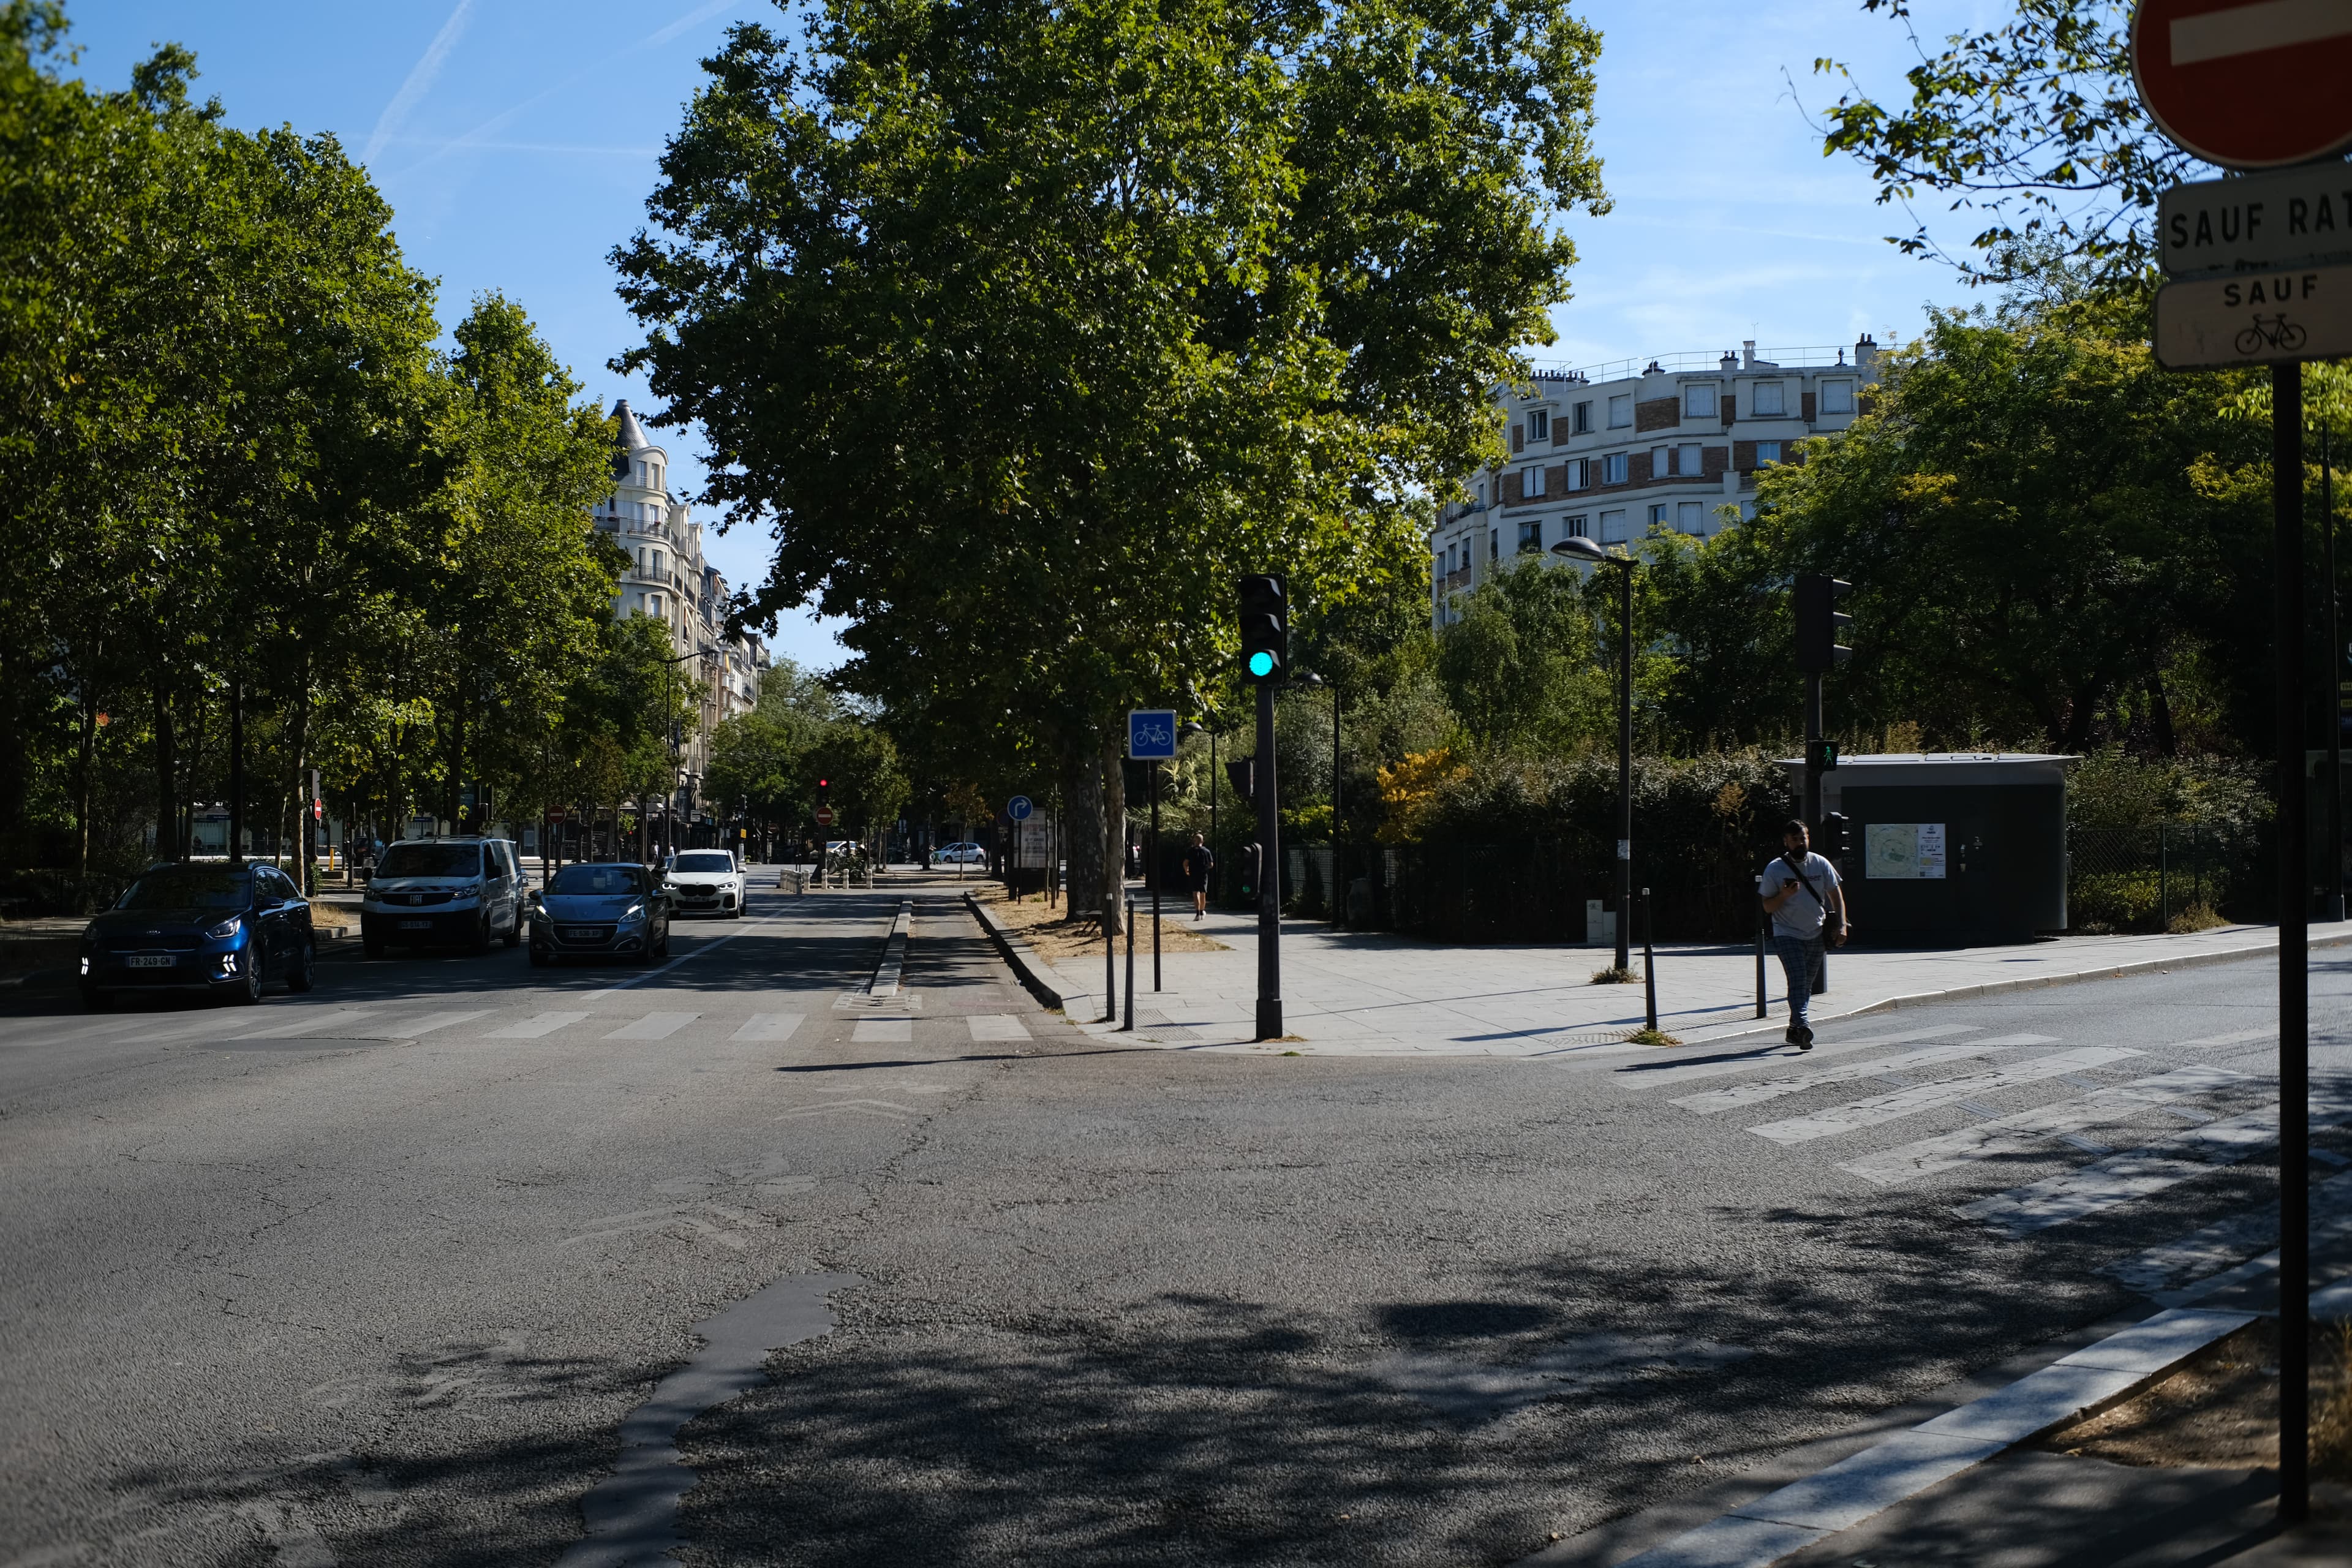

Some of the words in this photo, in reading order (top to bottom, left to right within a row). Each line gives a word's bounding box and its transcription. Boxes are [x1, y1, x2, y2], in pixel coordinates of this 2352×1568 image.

[2170, 203, 2264, 249] SAUF
[2224, 274, 2318, 307] SAUF
[409, 894, 423, 905] FIAT
[131, 957, 170, 966] FR-249-GN
